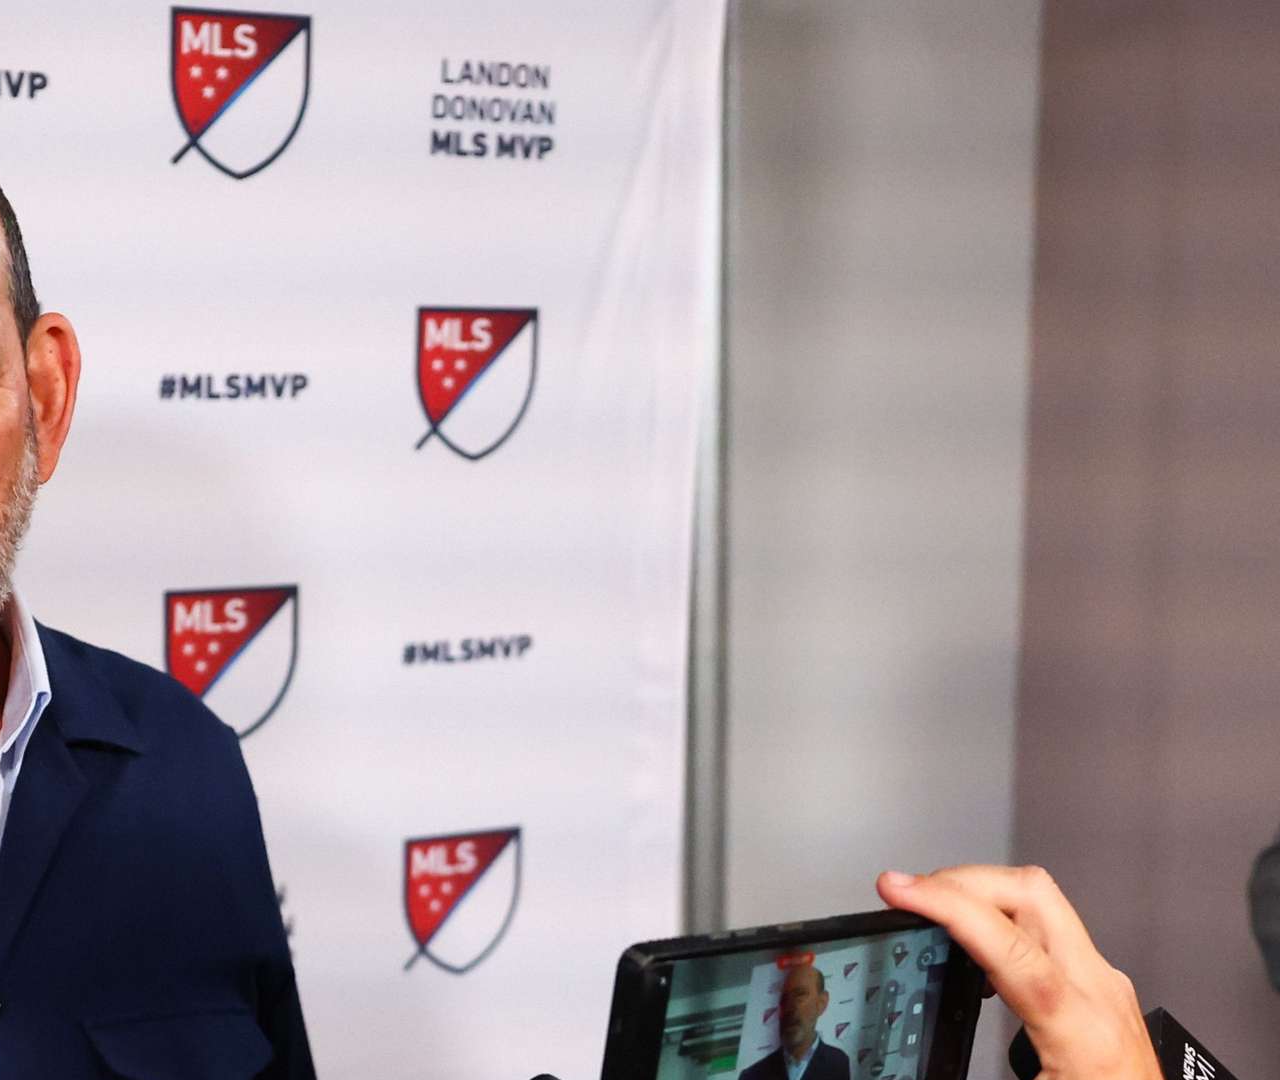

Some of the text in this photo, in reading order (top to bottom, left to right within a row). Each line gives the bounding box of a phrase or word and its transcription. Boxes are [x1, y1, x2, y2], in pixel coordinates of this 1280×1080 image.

[180, 20, 258, 58] MLS
[441, 59, 550, 90] LANDON
[432, 95, 556, 125] DONOVAN
[430, 132, 555, 160] MLS MVP
[424, 318, 493, 352] MLS
[159, 373, 309, 401] #MLSMVP
[173, 598, 248, 635] MLS
[402, 634, 533, 666] #MLSMVP
[410, 842, 479, 876] MLS
